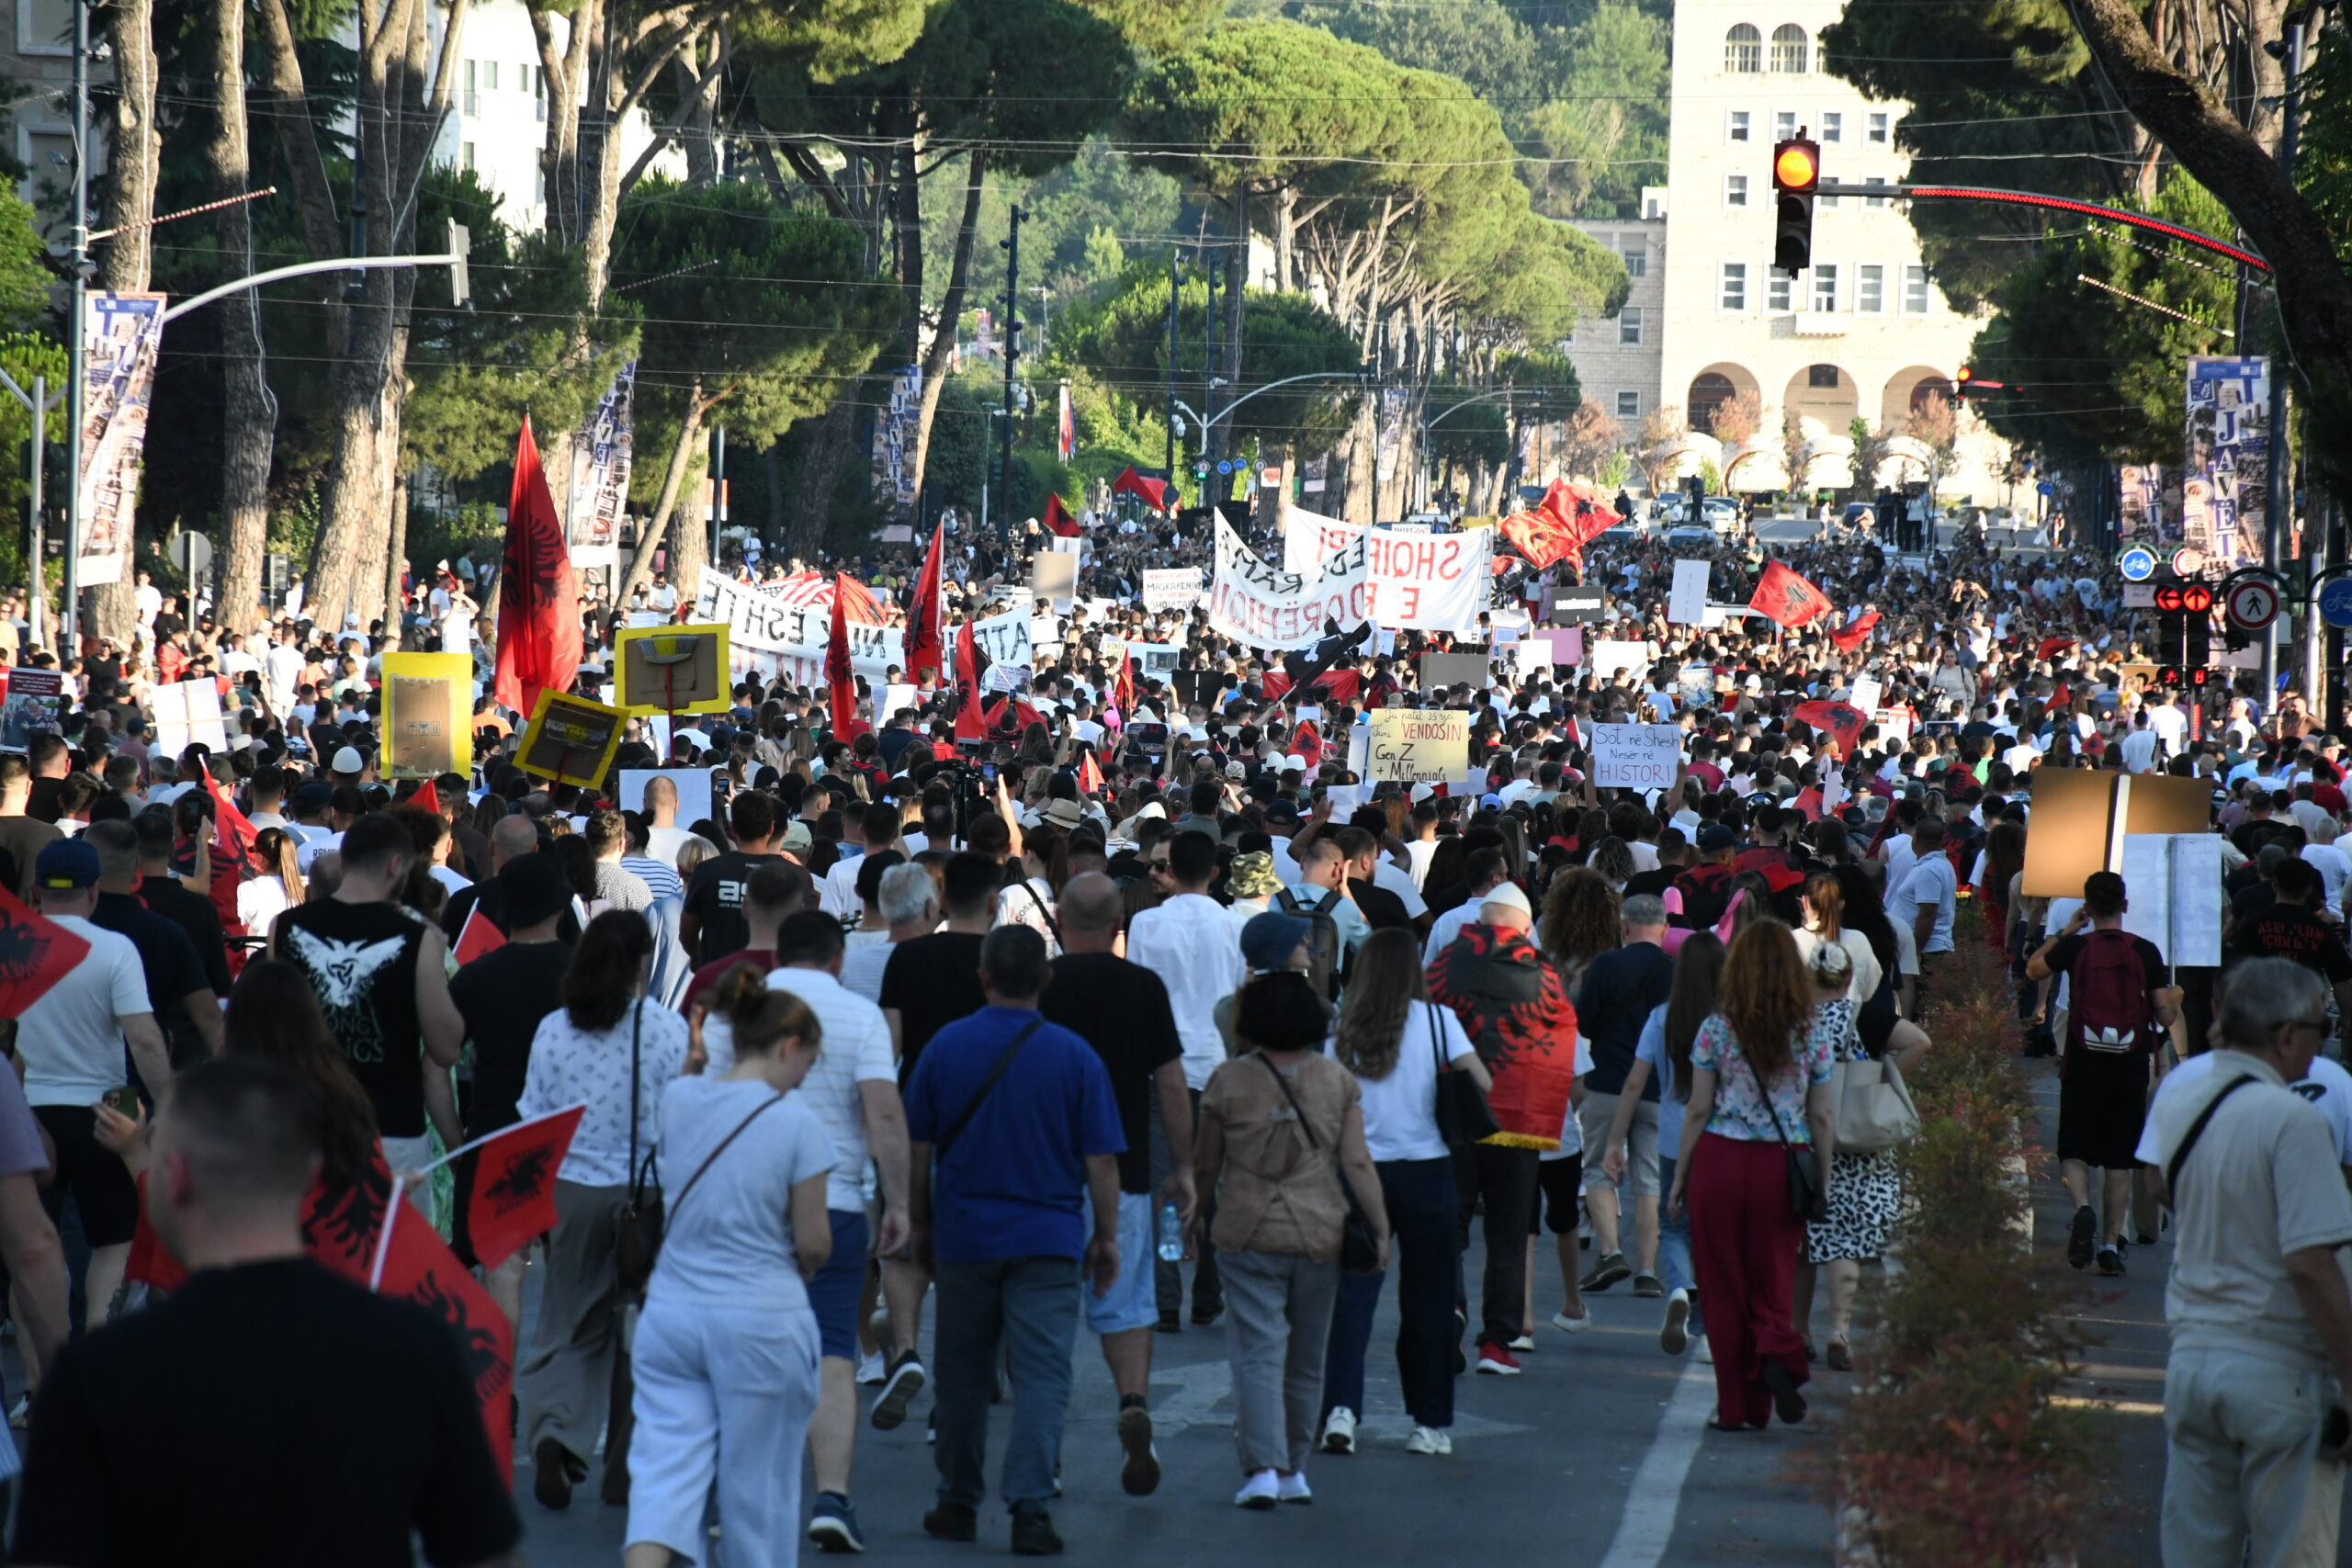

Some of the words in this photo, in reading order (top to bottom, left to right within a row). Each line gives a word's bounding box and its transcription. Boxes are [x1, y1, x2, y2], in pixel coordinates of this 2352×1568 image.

[2217, 411, 2238, 557] JAVËT
[1428, 712, 1438, 721] 35
[1402, 723, 1462, 741] VENDOSIN
[1594, 724, 1623, 745] Sot
[1643, 727, 1680, 748] Shesh
[1375, 743, 1396, 761] Gen
[1398, 742, 1415, 761] Z
[1389, 761, 1447, 782] Millennials
[1600, 763, 1670, 783] HISTORI
